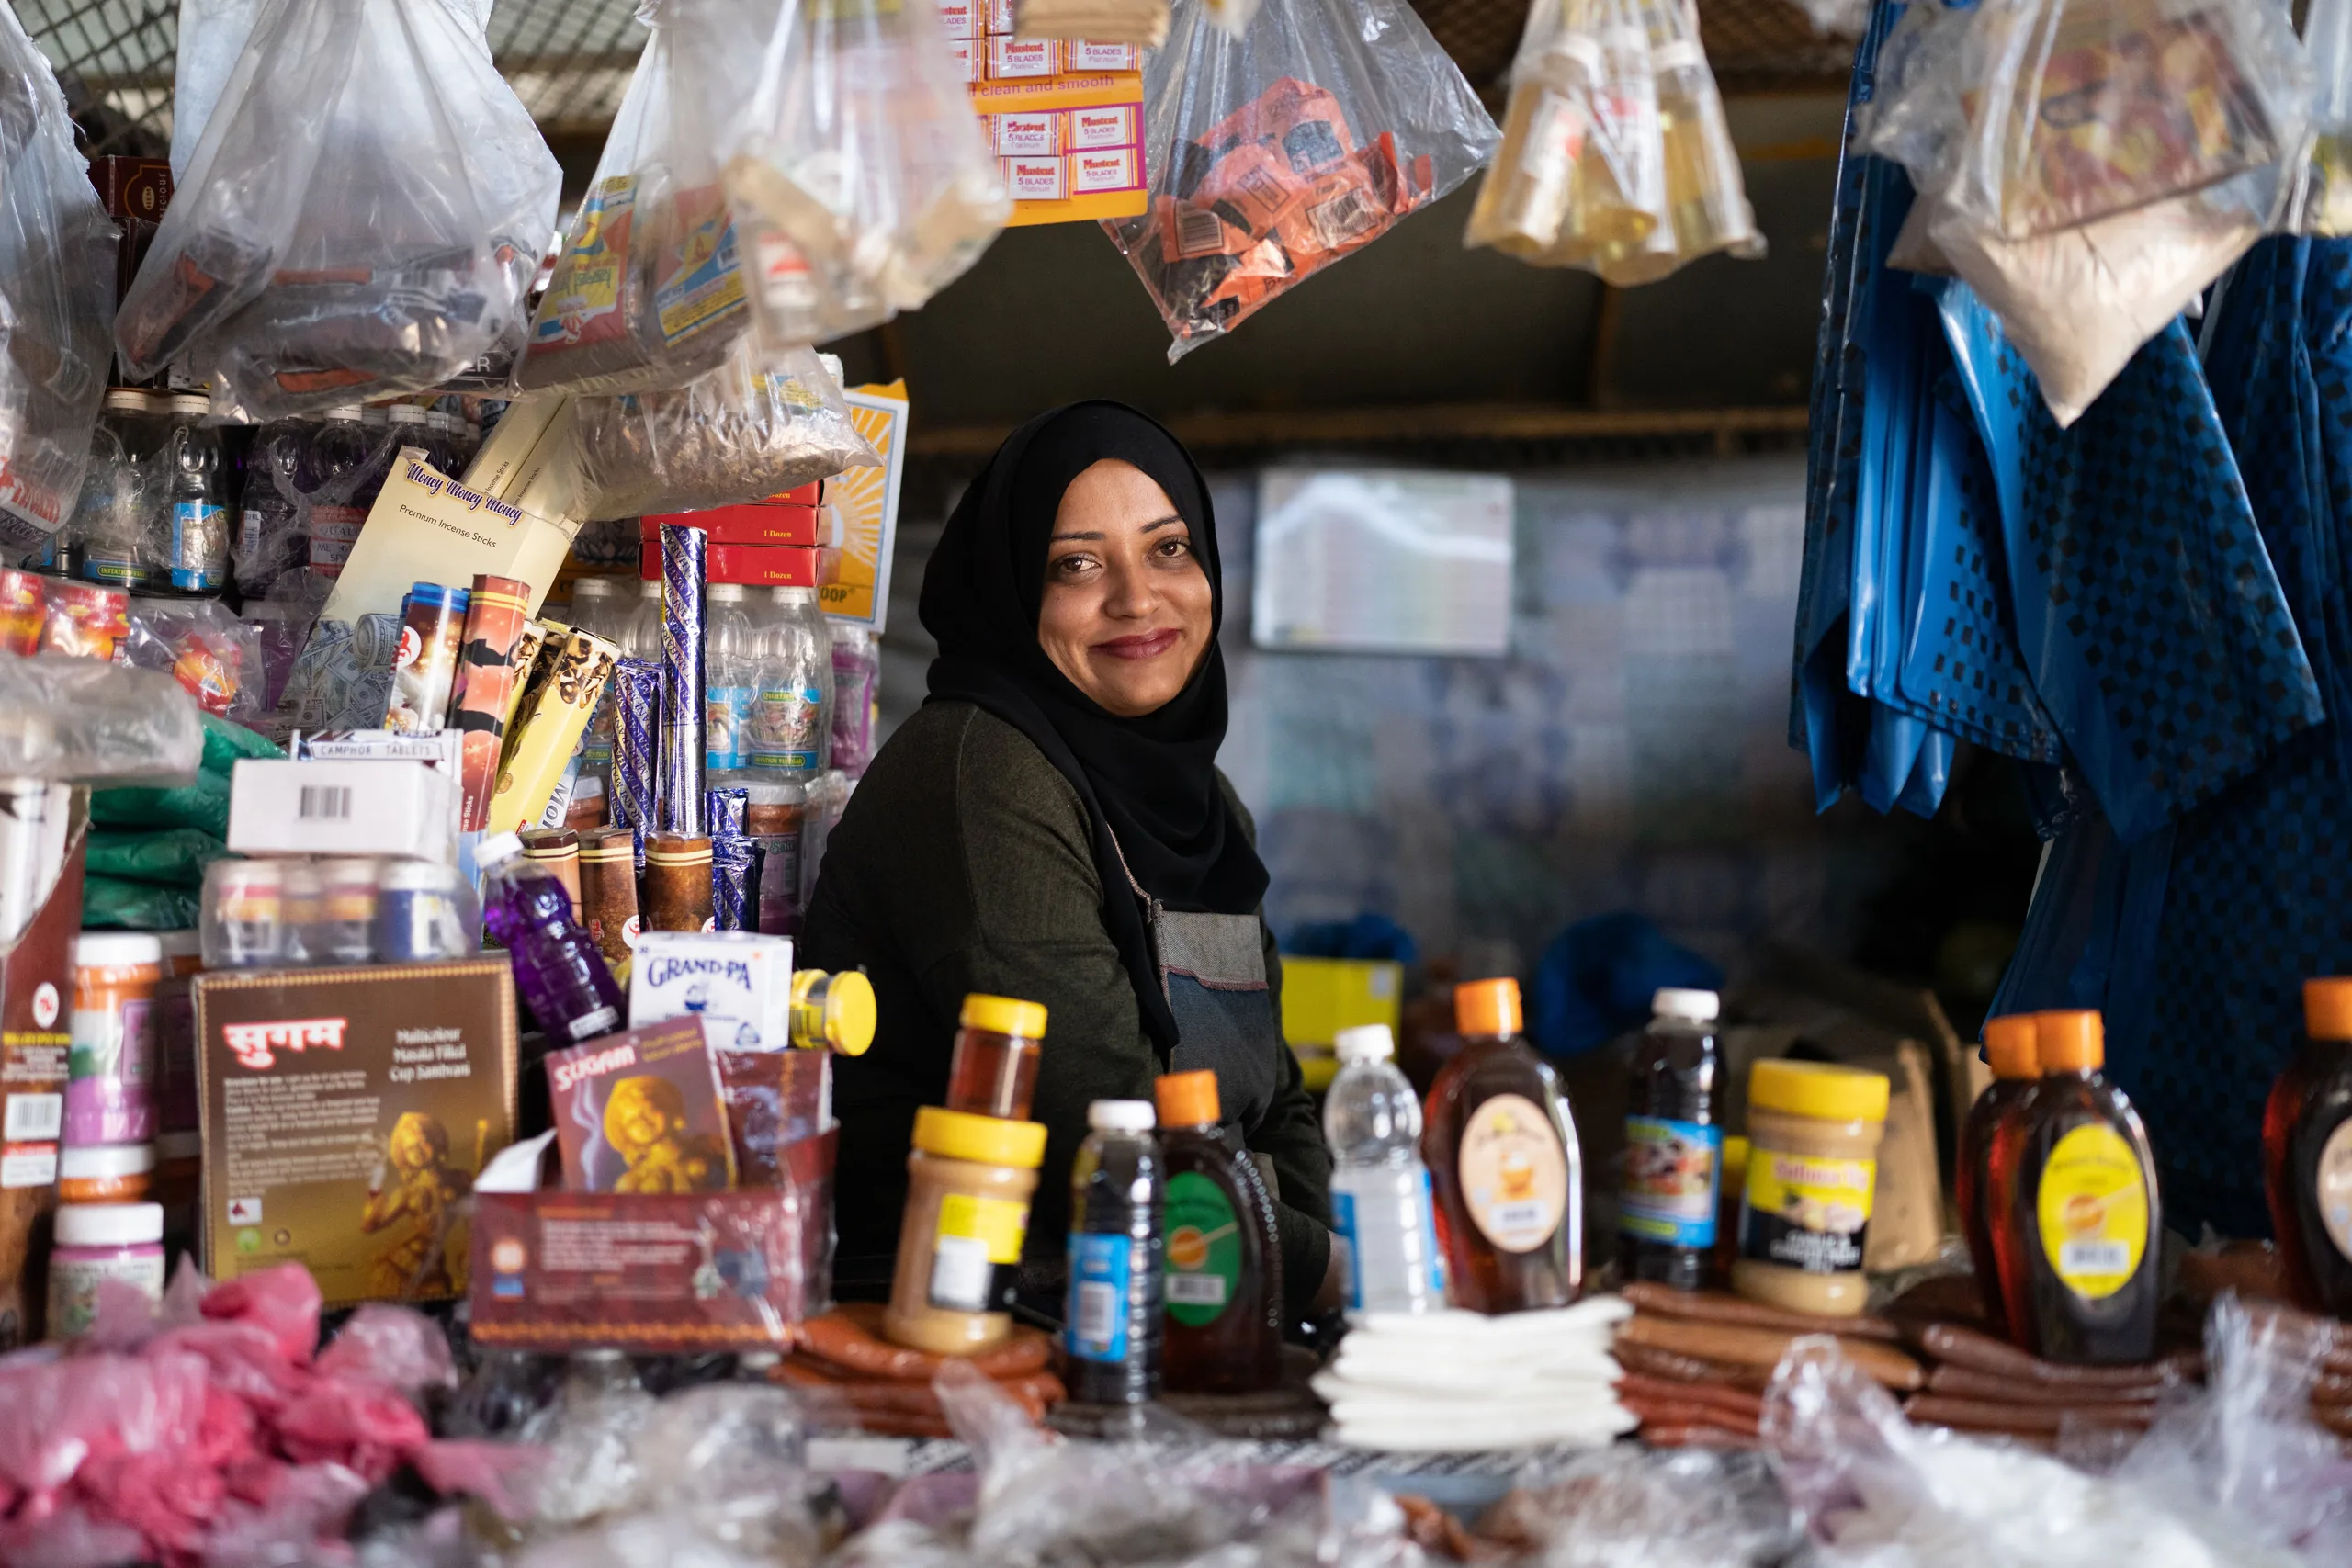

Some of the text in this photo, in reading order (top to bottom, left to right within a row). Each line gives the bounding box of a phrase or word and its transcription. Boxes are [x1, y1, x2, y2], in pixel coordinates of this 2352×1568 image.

[1005, 42, 1045, 55] Mustcut
[1092, 48, 1122, 56] BLADES
[1014, 54, 1044, 62] BLADES
[981, 84, 1021, 96] clean
[1026, 80, 1053, 93] and
[1058, 74, 1114, 90] smooth
[1082, 116, 1119, 127] Mustcut
[1091, 127, 1116, 135] BLADES
[1083, 159, 1121, 170] Mustcut
[1016, 165, 1056, 177] Mustcut
[1092, 169, 1118, 177] BLADES
[486, 460, 510, 493] Incense Sticks
[516, 467, 541, 500] Incense Sticks
[406, 462, 524, 526] Money Money Money
[399, 504, 497, 548] Premium Incense Sticks
[770, 530, 792, 538] Dozen
[770, 571, 792, 580] Dozen
[321, 745, 430, 756] CAMPHOR TABLETS
[648, 956, 752, 992] GRAND-PA
[222, 1017, 348, 1069] सुगम
[388, 1065, 415, 1084] Cup
[553, 1044, 637, 1093] SUGAM
